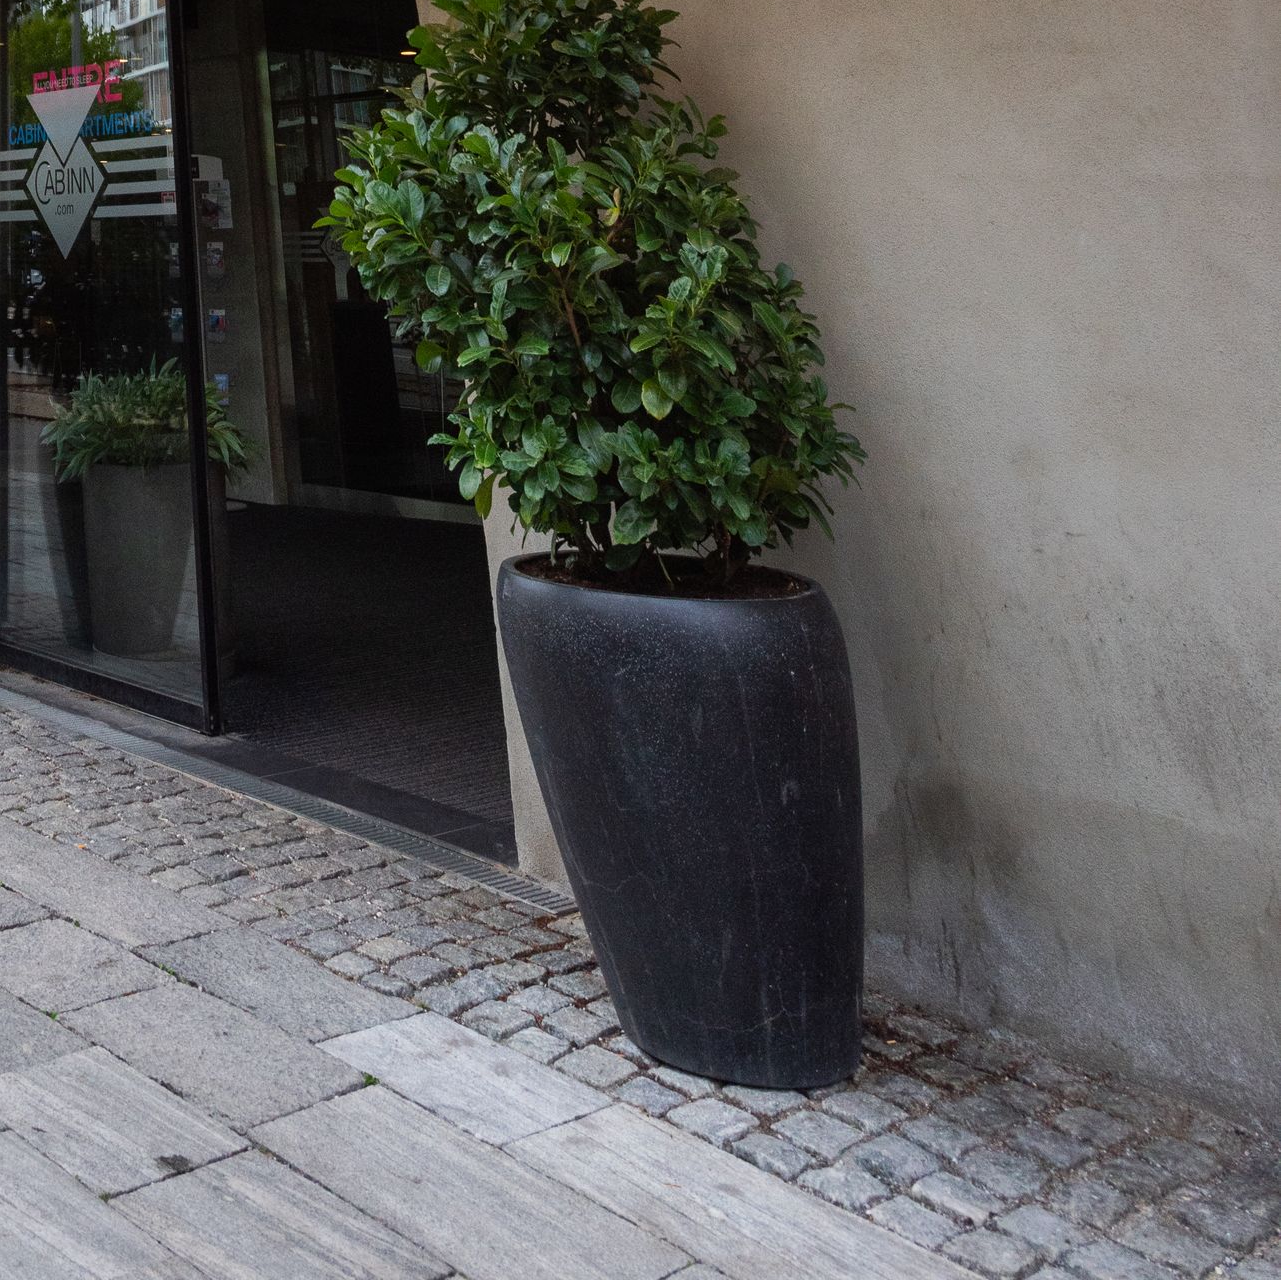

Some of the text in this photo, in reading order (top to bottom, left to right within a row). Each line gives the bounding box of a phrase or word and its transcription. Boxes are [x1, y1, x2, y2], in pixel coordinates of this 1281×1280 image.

[8, 123, 48, 146] CABIN
[35, 161, 95, 205] CABINN
[54, 203, 74, 215] .com
